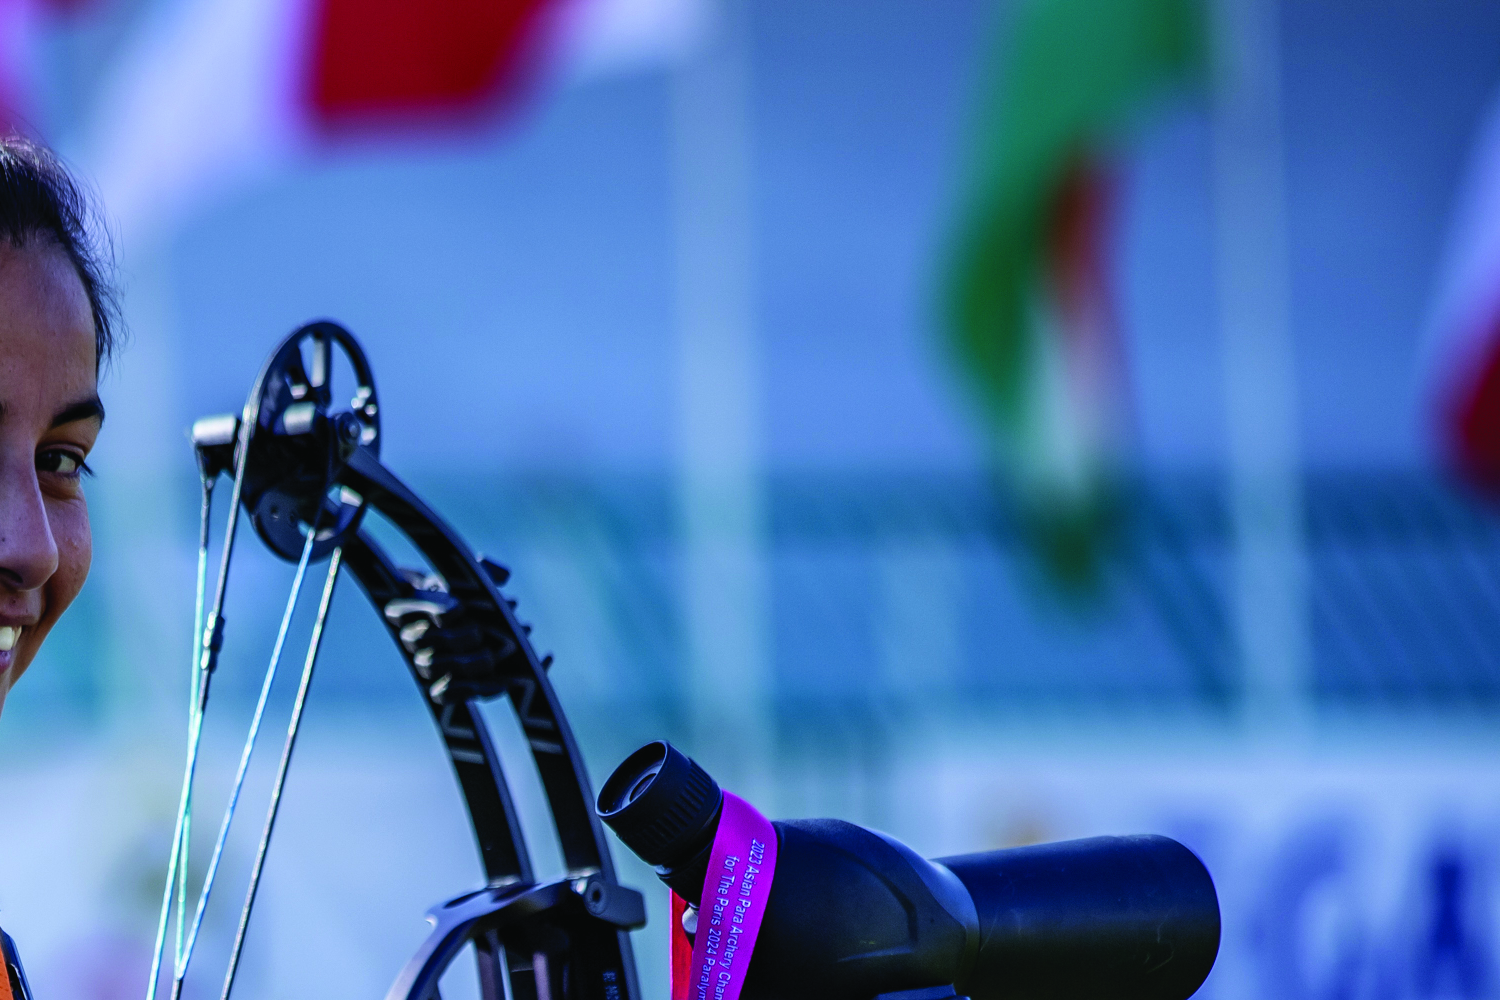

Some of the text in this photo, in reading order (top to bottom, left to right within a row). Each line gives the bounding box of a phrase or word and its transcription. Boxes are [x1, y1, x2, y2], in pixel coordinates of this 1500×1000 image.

[724, 854, 740, 873] for
[749, 838, 765, 866] 2023
[717, 875, 736, 895] The
[741, 864, 760, 897] Asian
[711, 897, 729, 926] Paris
[733, 896, 752, 924] Para
[706, 928, 722, 955] 2024
[718, 925, 743, 970] Archery
